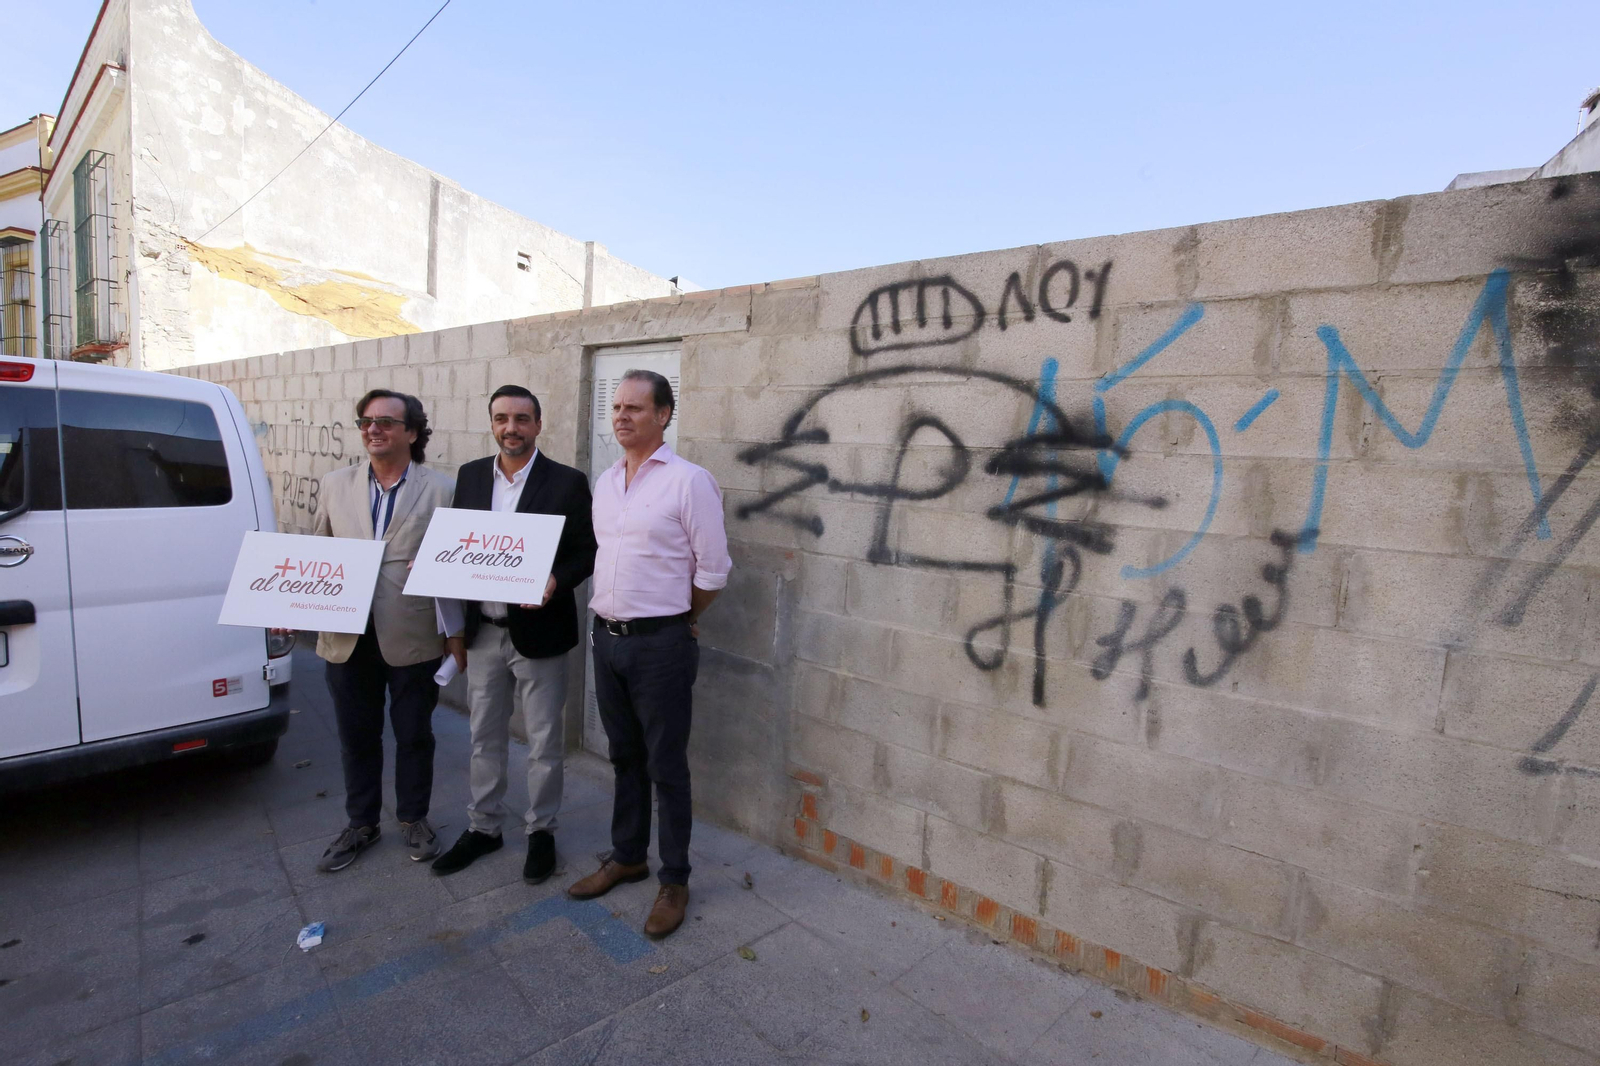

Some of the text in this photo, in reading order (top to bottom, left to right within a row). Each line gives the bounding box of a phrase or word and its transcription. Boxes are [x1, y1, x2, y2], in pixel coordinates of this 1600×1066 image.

[282, 470, 320, 515] PUEB
[435, 545, 523, 568] al centro
[250, 572, 343, 596] al centro
[215, 682, 226, 694] 5
